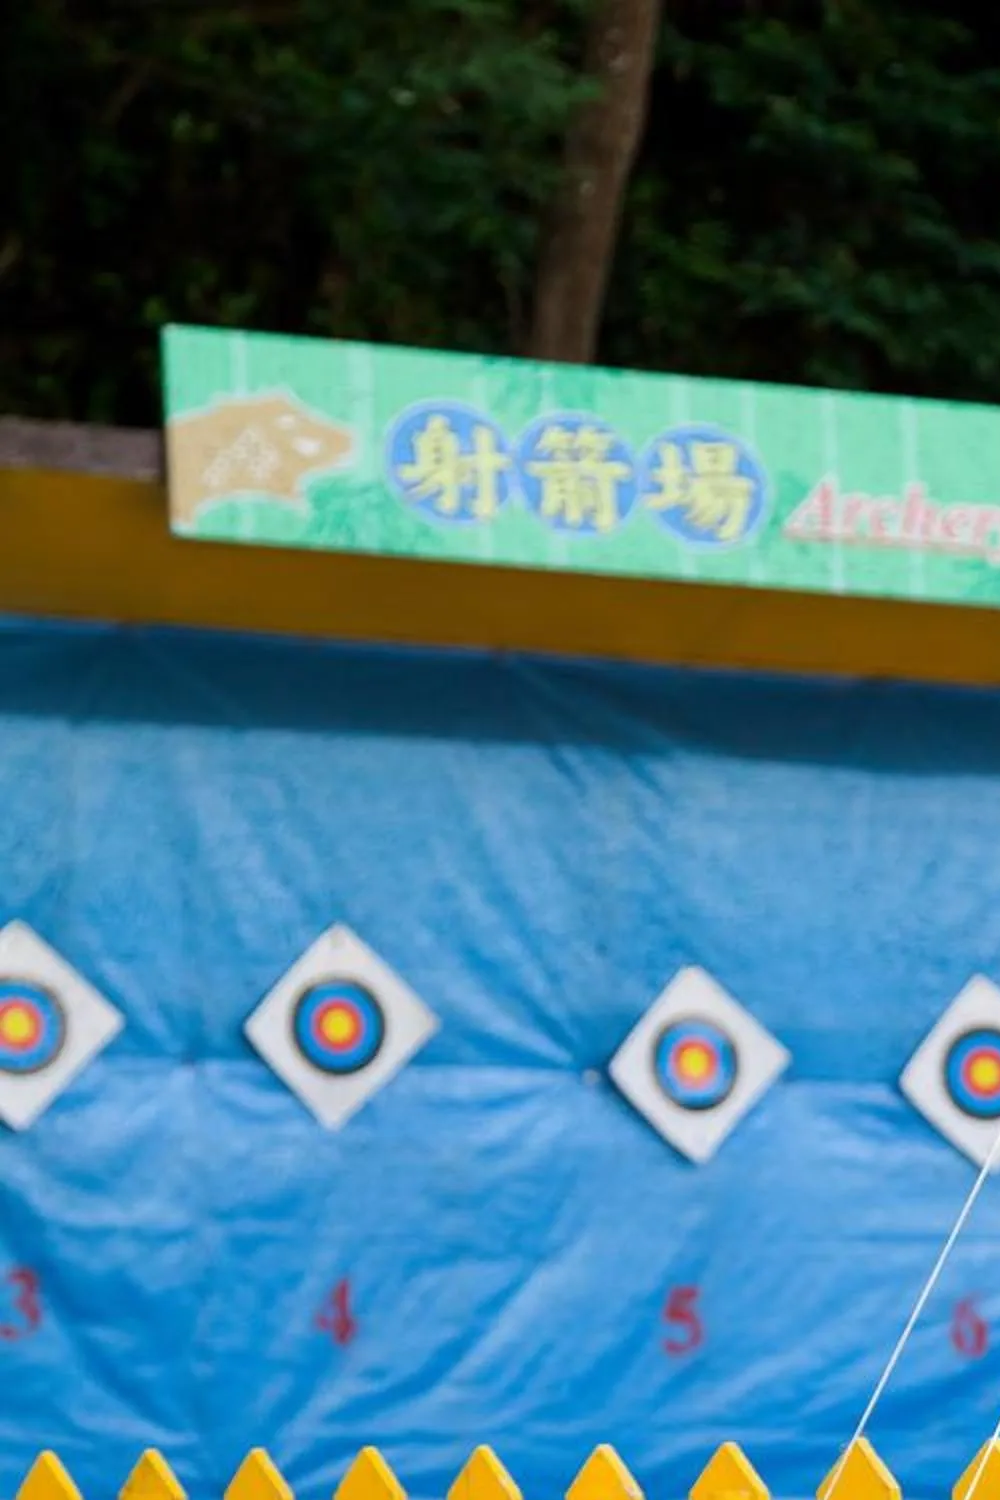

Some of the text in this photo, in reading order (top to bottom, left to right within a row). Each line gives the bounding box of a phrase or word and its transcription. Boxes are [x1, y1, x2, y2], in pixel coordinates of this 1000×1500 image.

[397, 414, 755, 541] 射箭場
[0, 1267, 42, 1341] 3
[315, 1279, 356, 1345] 4
[661, 1286, 704, 1355] 5
[951, 1294, 988, 1358] 6
